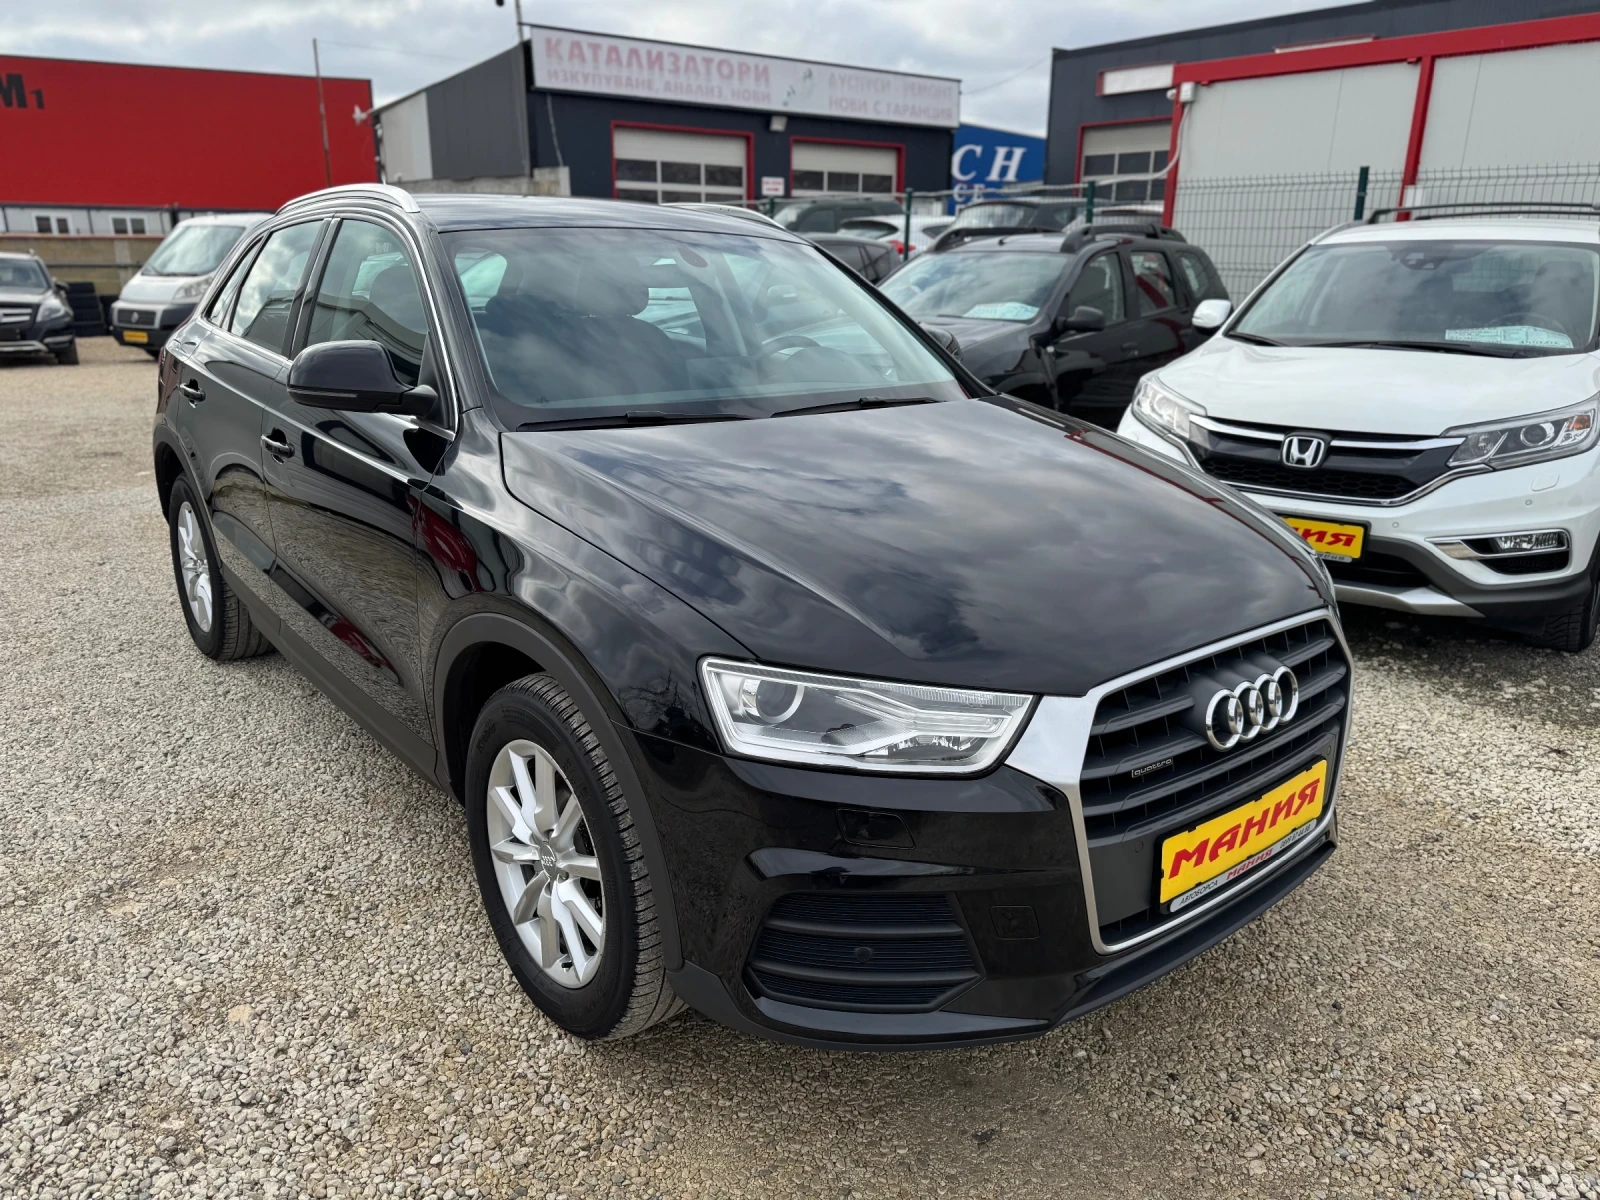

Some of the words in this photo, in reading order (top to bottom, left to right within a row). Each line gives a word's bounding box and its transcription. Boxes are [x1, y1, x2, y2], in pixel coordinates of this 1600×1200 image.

[545, 36, 770, 85] КАТАЛИЗАТОРИ
[731, 88, 771, 105] НОВИ
[828, 97, 868, 113] НОВИ
[886, 103, 953, 121] ГАРАНЦИЯ
[1132, 758, 1173, 777] quattro
[1168, 778, 1320, 879] МАНИЯ
[1226, 849, 1273, 880] МАНИЯ
